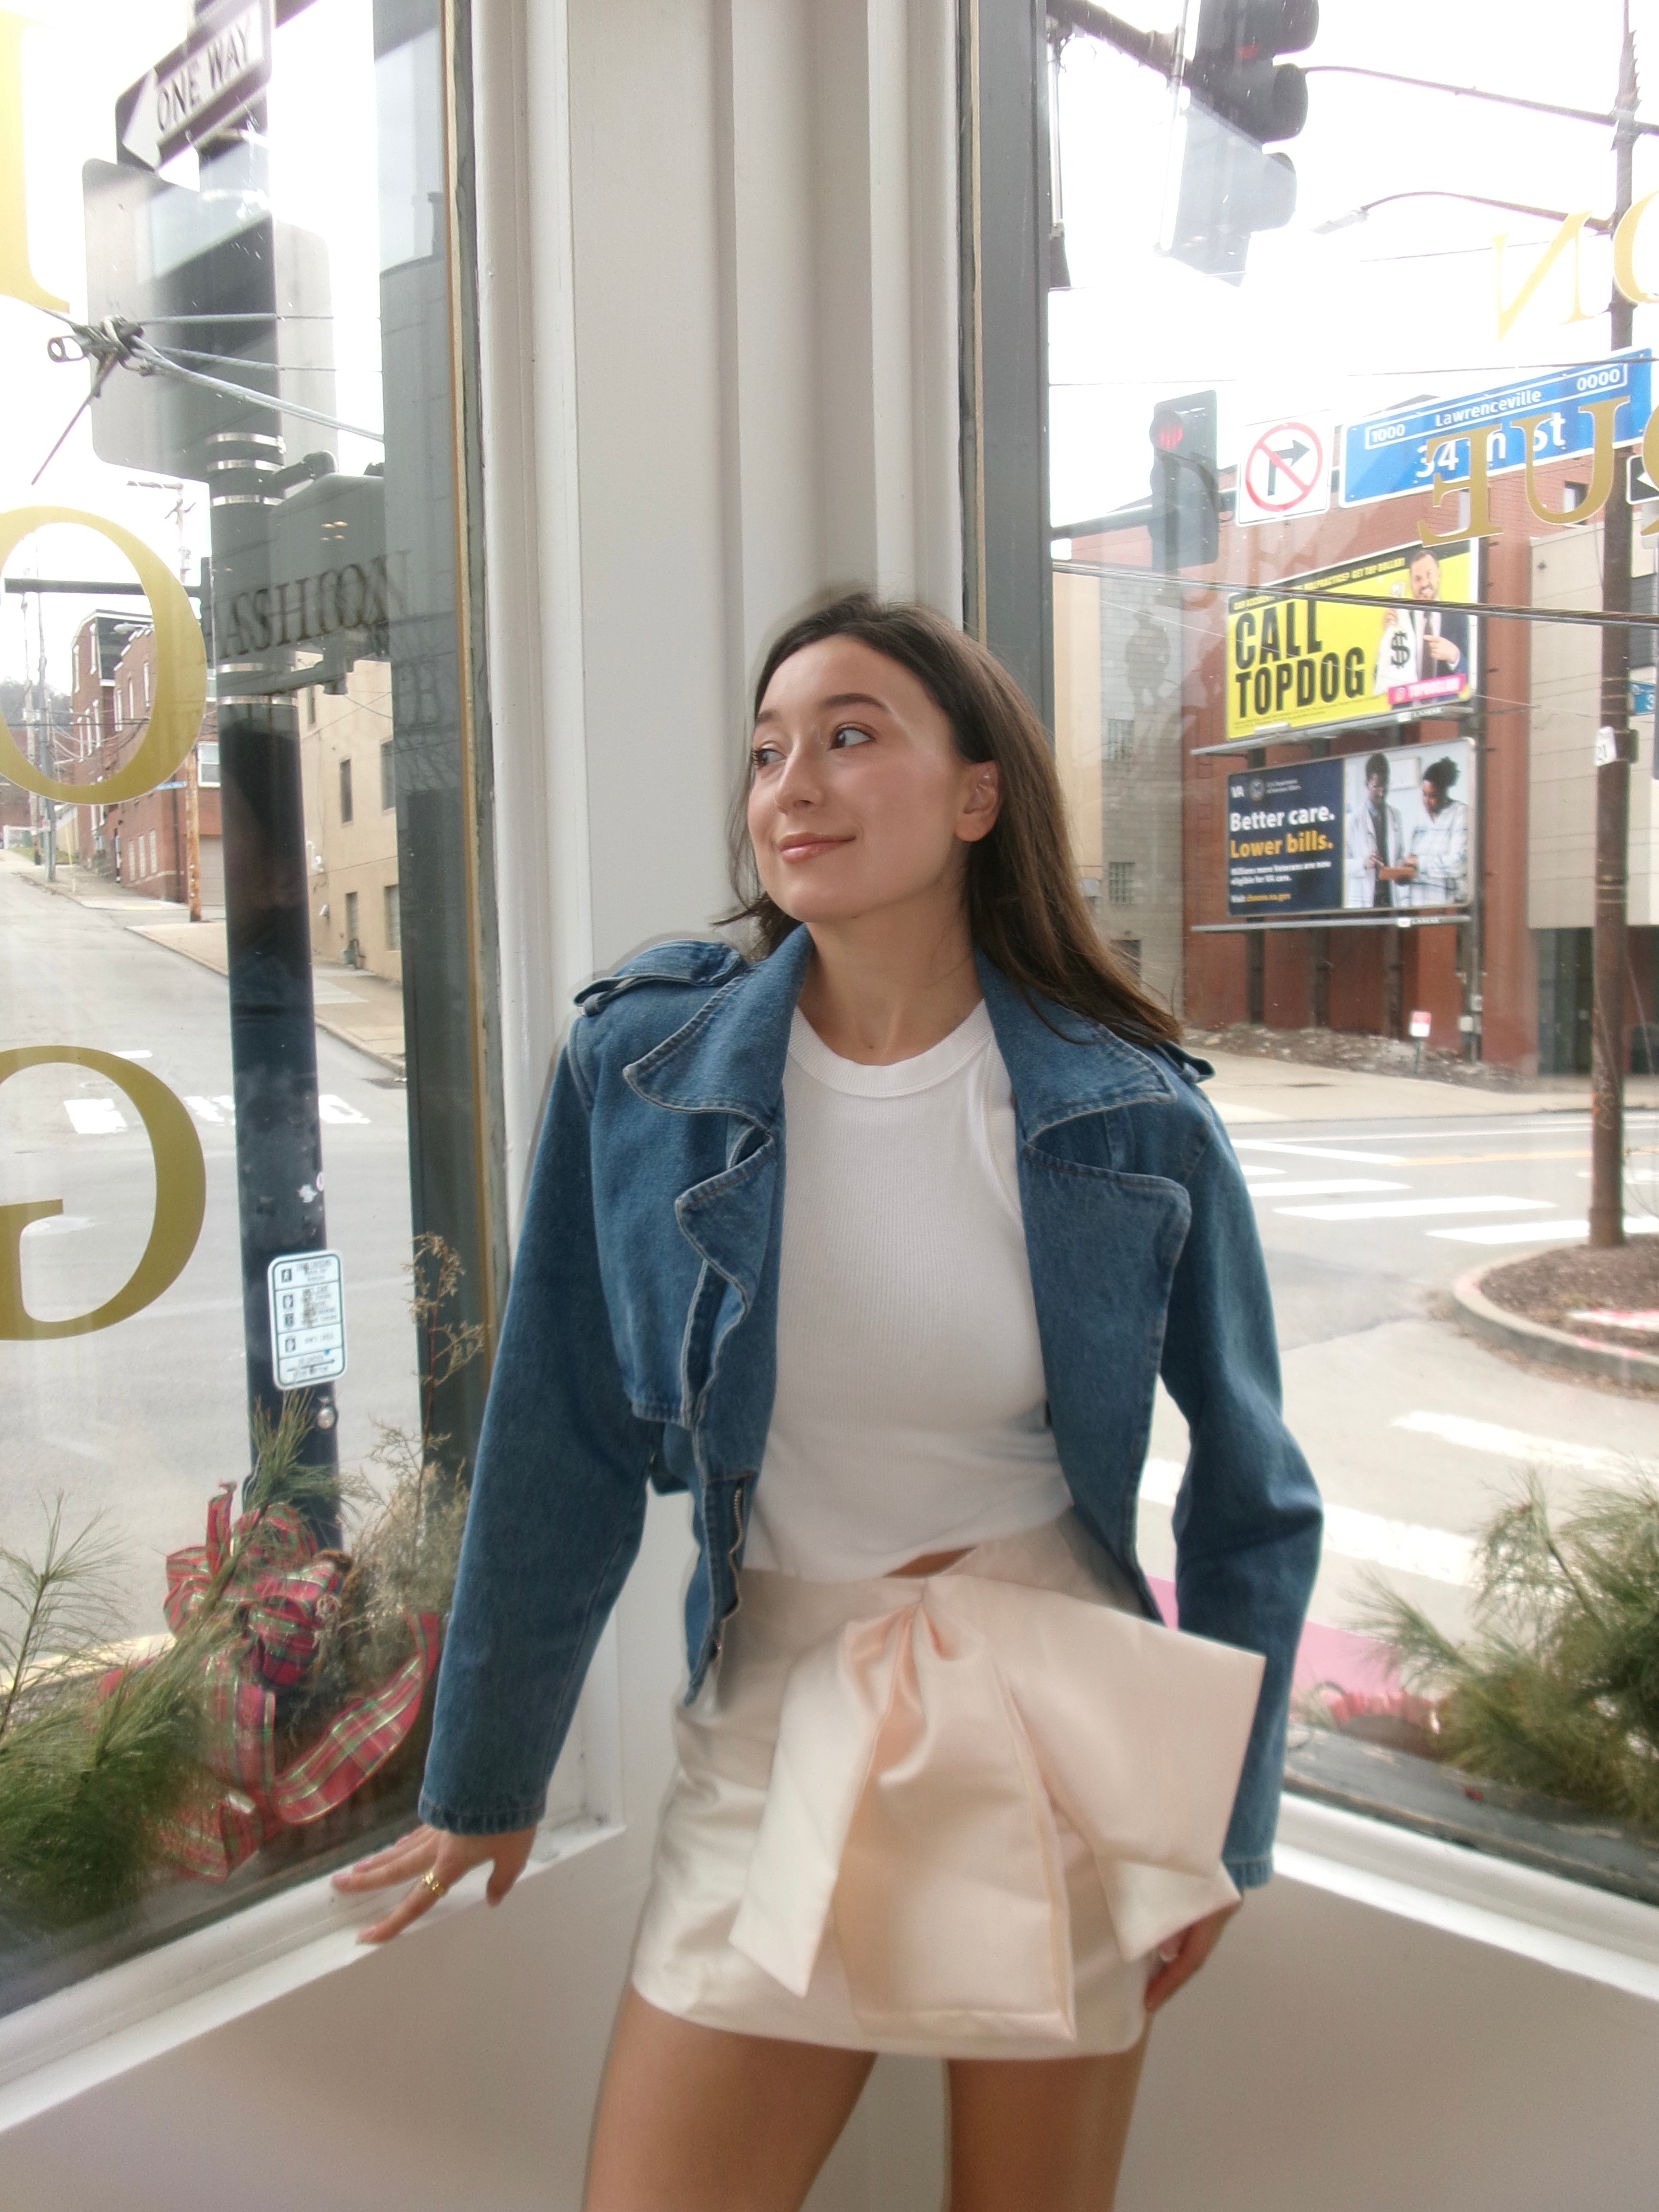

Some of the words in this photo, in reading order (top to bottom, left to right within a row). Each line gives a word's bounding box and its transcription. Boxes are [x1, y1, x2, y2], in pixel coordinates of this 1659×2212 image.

[157, 62, 200, 133] ONE
[206, 18, 249, 90] WAY
[1371, 423, 1406, 443] 1000
[1435, 389, 1542, 427] Lawrenceville
[1576, 368, 1620, 391] 0000
[1236, 600, 1322, 670] CALL
[1236, 647, 1365, 718] TOPDOG
[1230, 811, 1285, 832] Better
[1288, 806, 1335, 825] care.
[1230, 840, 1283, 859] Lower
[1286, 830, 1334, 854] bills.
